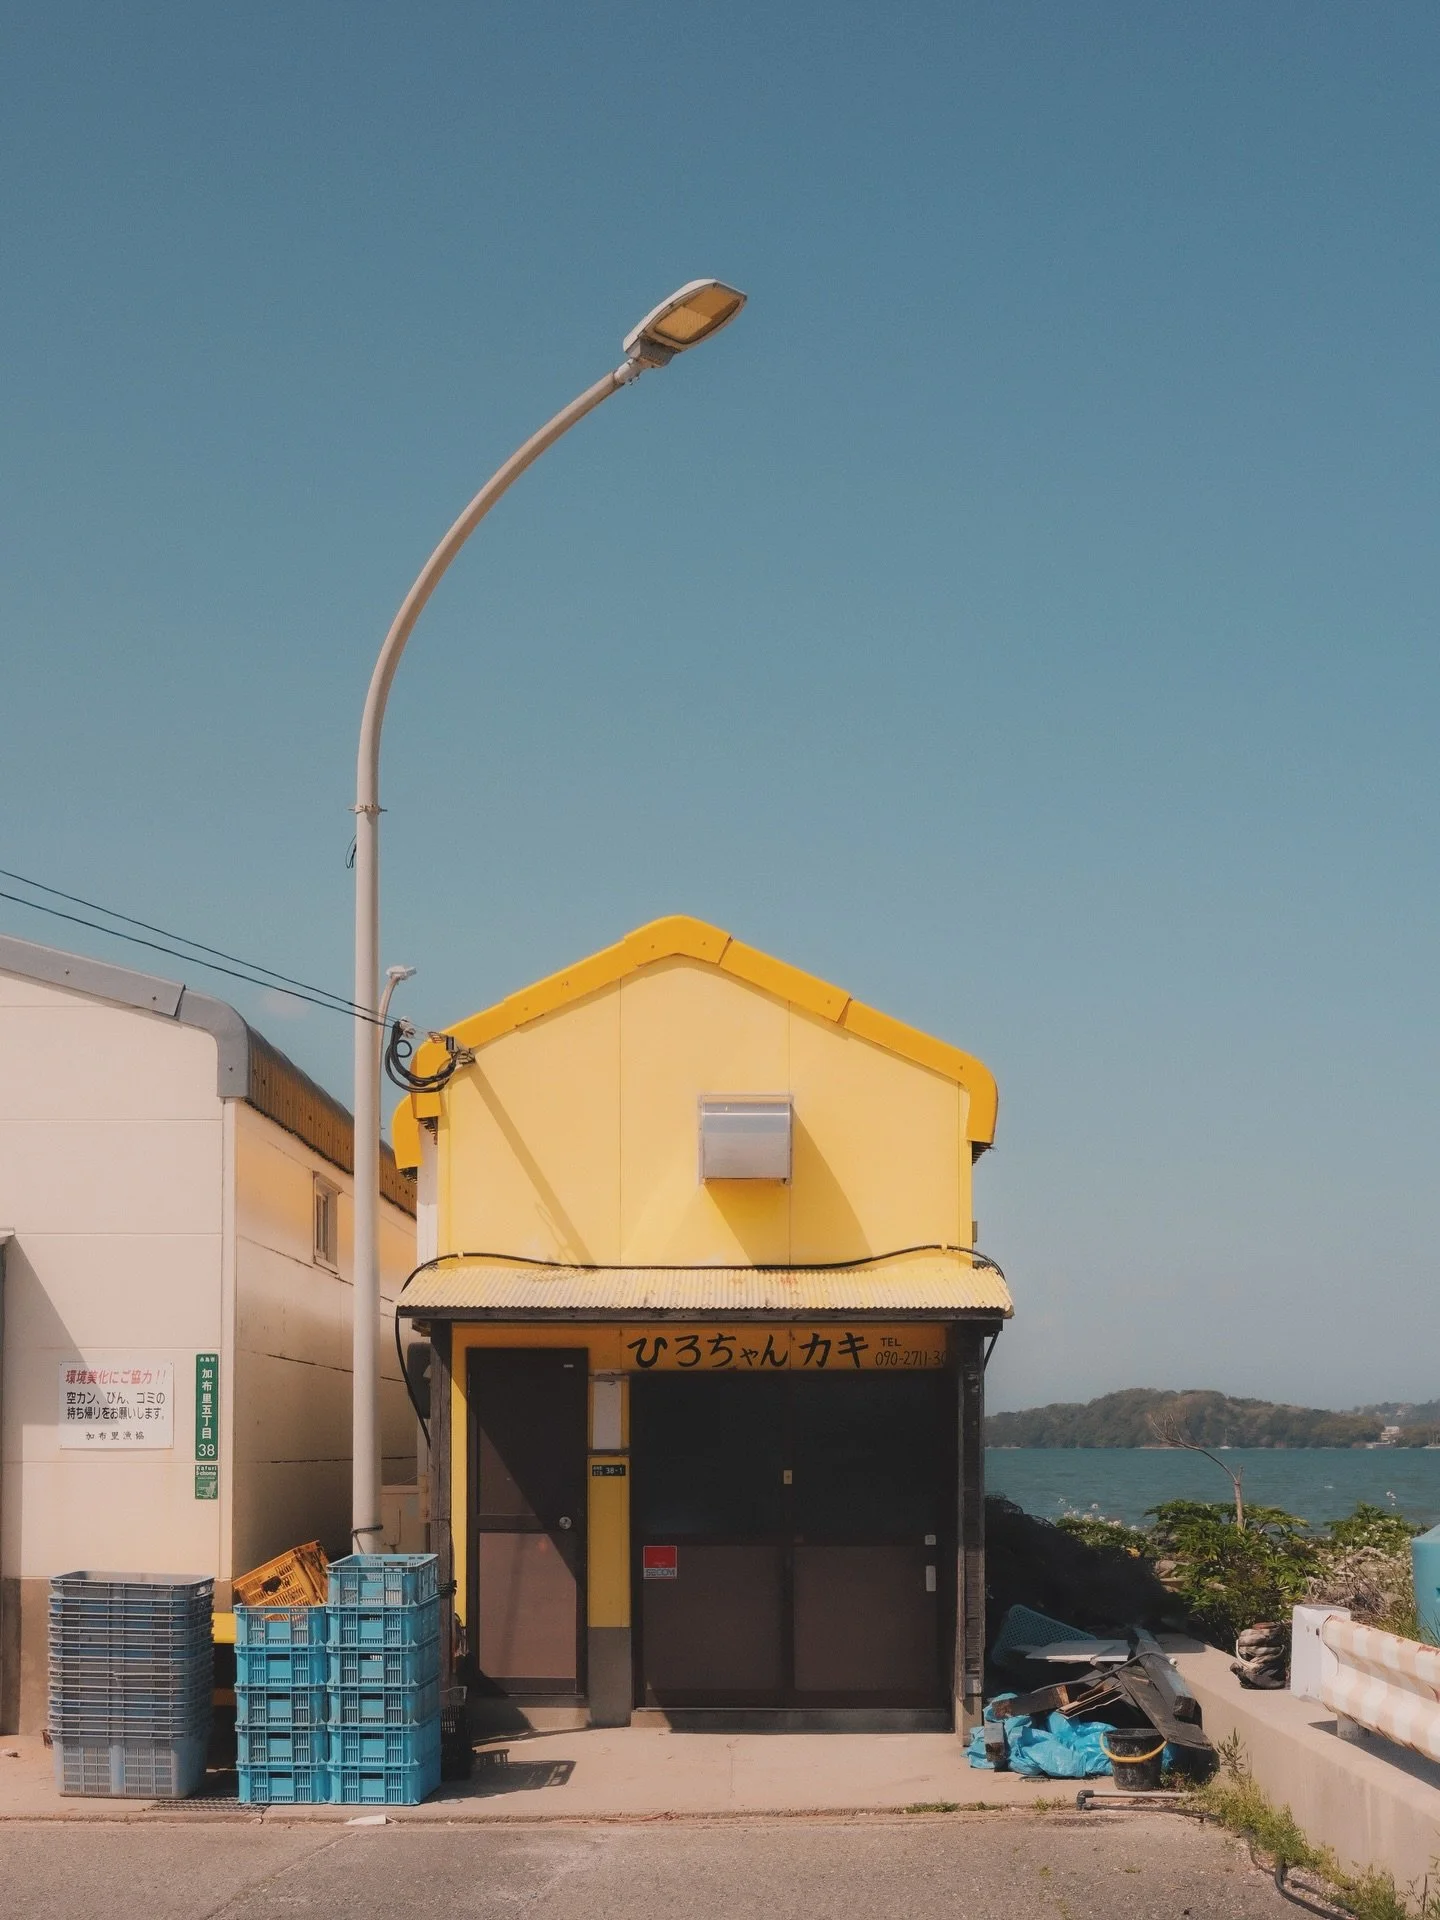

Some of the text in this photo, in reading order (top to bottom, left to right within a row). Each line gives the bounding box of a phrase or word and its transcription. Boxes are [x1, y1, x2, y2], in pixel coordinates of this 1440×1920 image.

[627, 1332, 869, 1369] ひろちゃん カキ
[880, 1337, 902, 1347] TEL
[66, 1391, 166, 1405] 空カン、びん、ゴミの
[198, 1368, 215, 1457] 加布里五丁目 38
